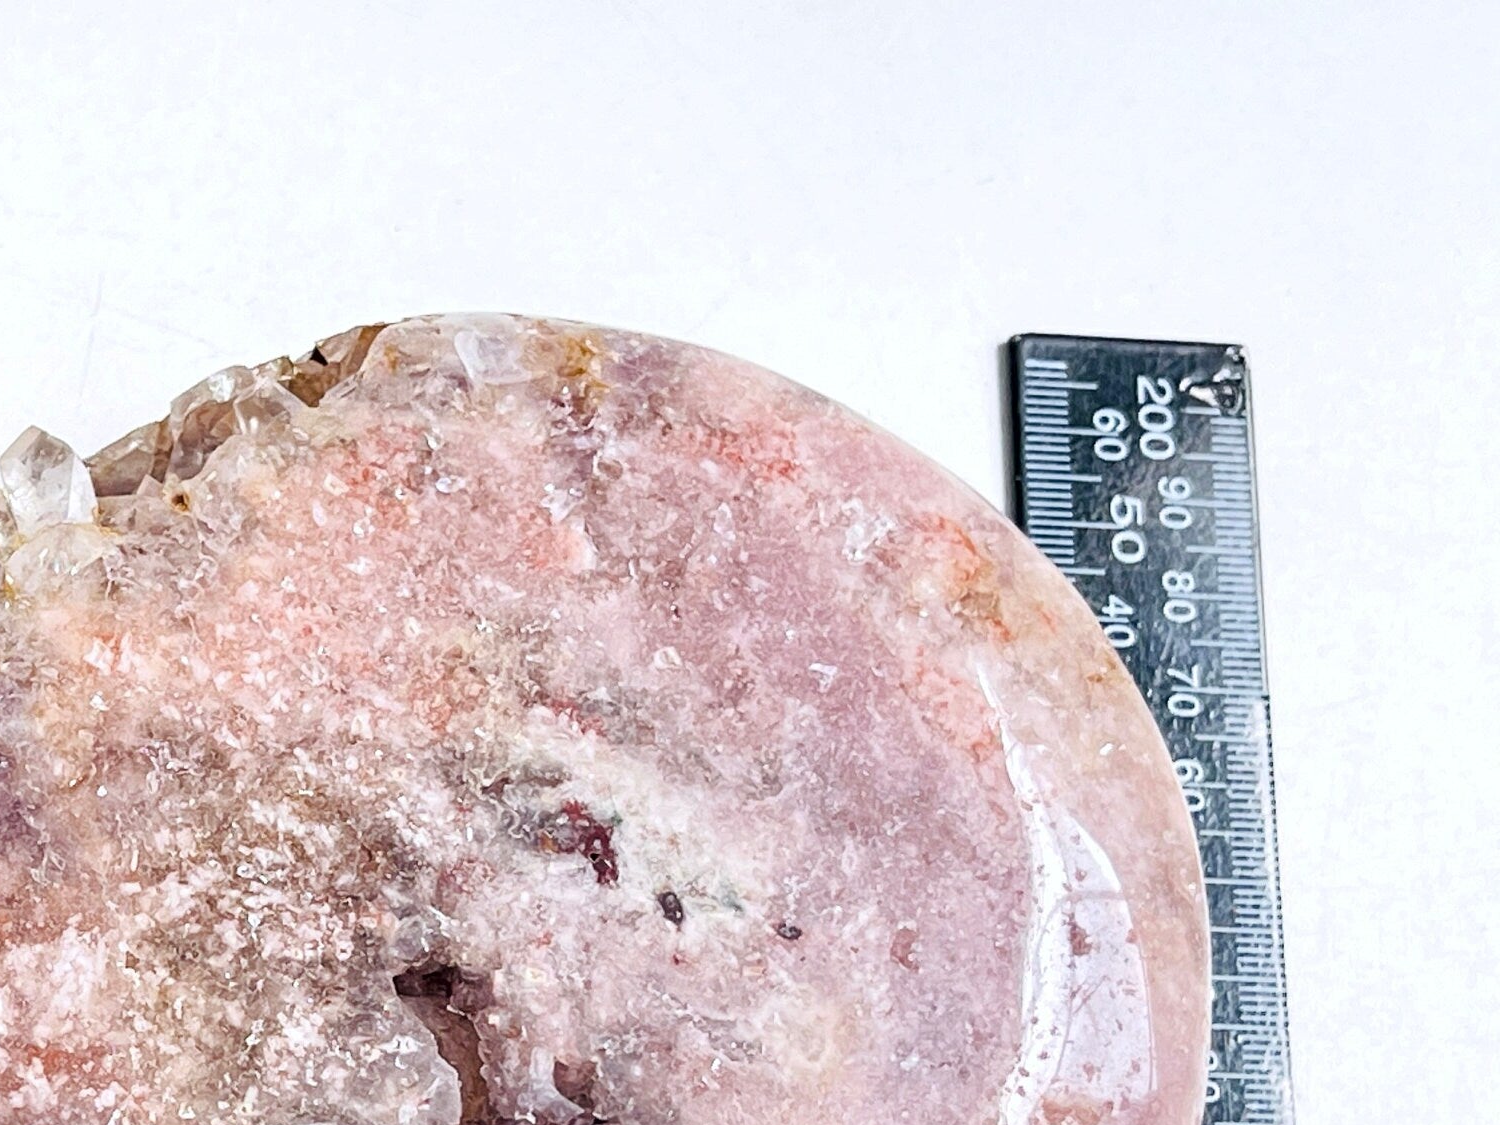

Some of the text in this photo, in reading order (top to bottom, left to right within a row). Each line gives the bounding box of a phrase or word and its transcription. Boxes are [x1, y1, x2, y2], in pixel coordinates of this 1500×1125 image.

[1093, 408, 1130, 462] 60
[1136, 375, 1177, 461] 200
[1110, 495, 1146, 565] 50
[1157, 475, 1193, 530] 90
[1101, 594, 1136, 649] 40
[1162, 569, 1197, 624] 80
[1166, 664, 1202, 719] 70
